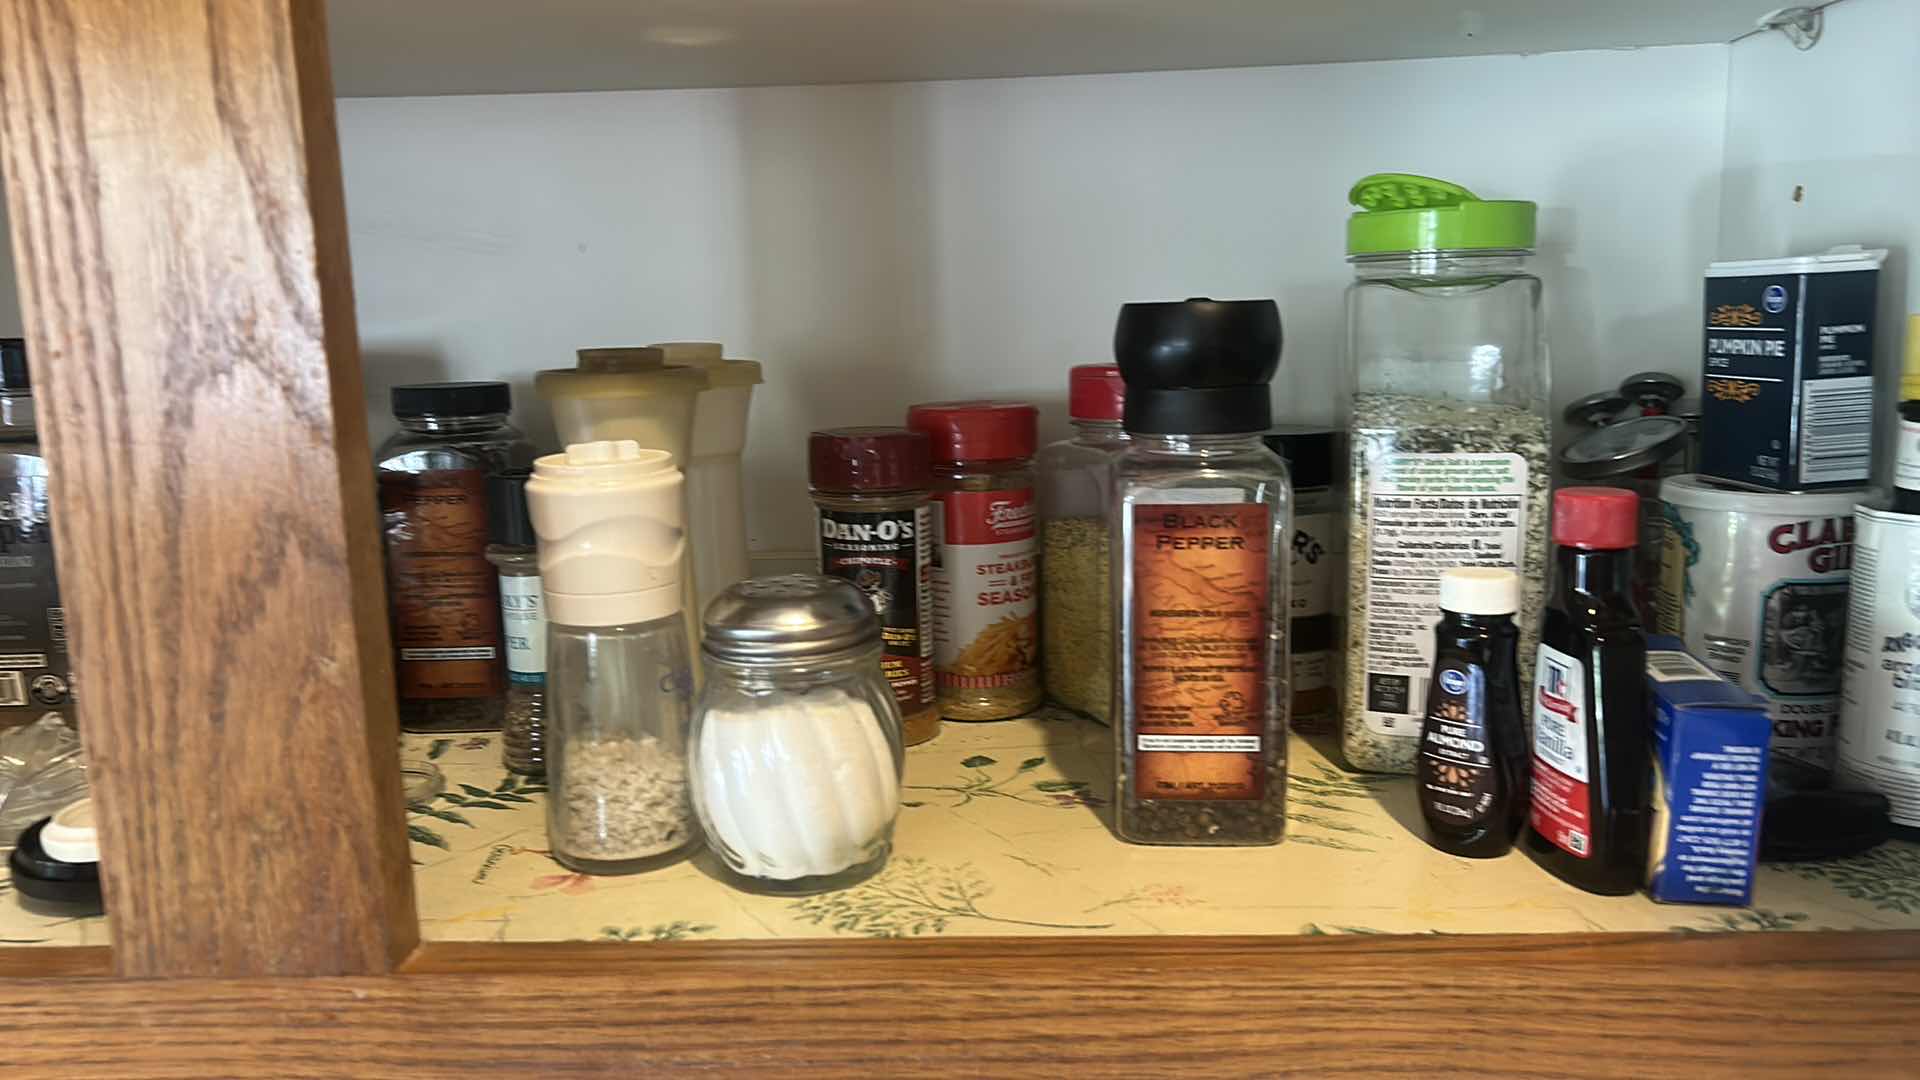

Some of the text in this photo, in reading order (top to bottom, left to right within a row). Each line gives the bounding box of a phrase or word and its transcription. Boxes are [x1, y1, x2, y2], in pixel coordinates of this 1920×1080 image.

[1708, 338, 1786, 357] PUMPKIN PIE
[1163, 513, 1238, 528] BLACK
[822, 518, 914, 541] DAN-O'S
[1156, 534, 1246, 550] PEPPER
[1440, 724, 1467, 738] PURE
[1426, 730, 1486, 753] ALMOND
